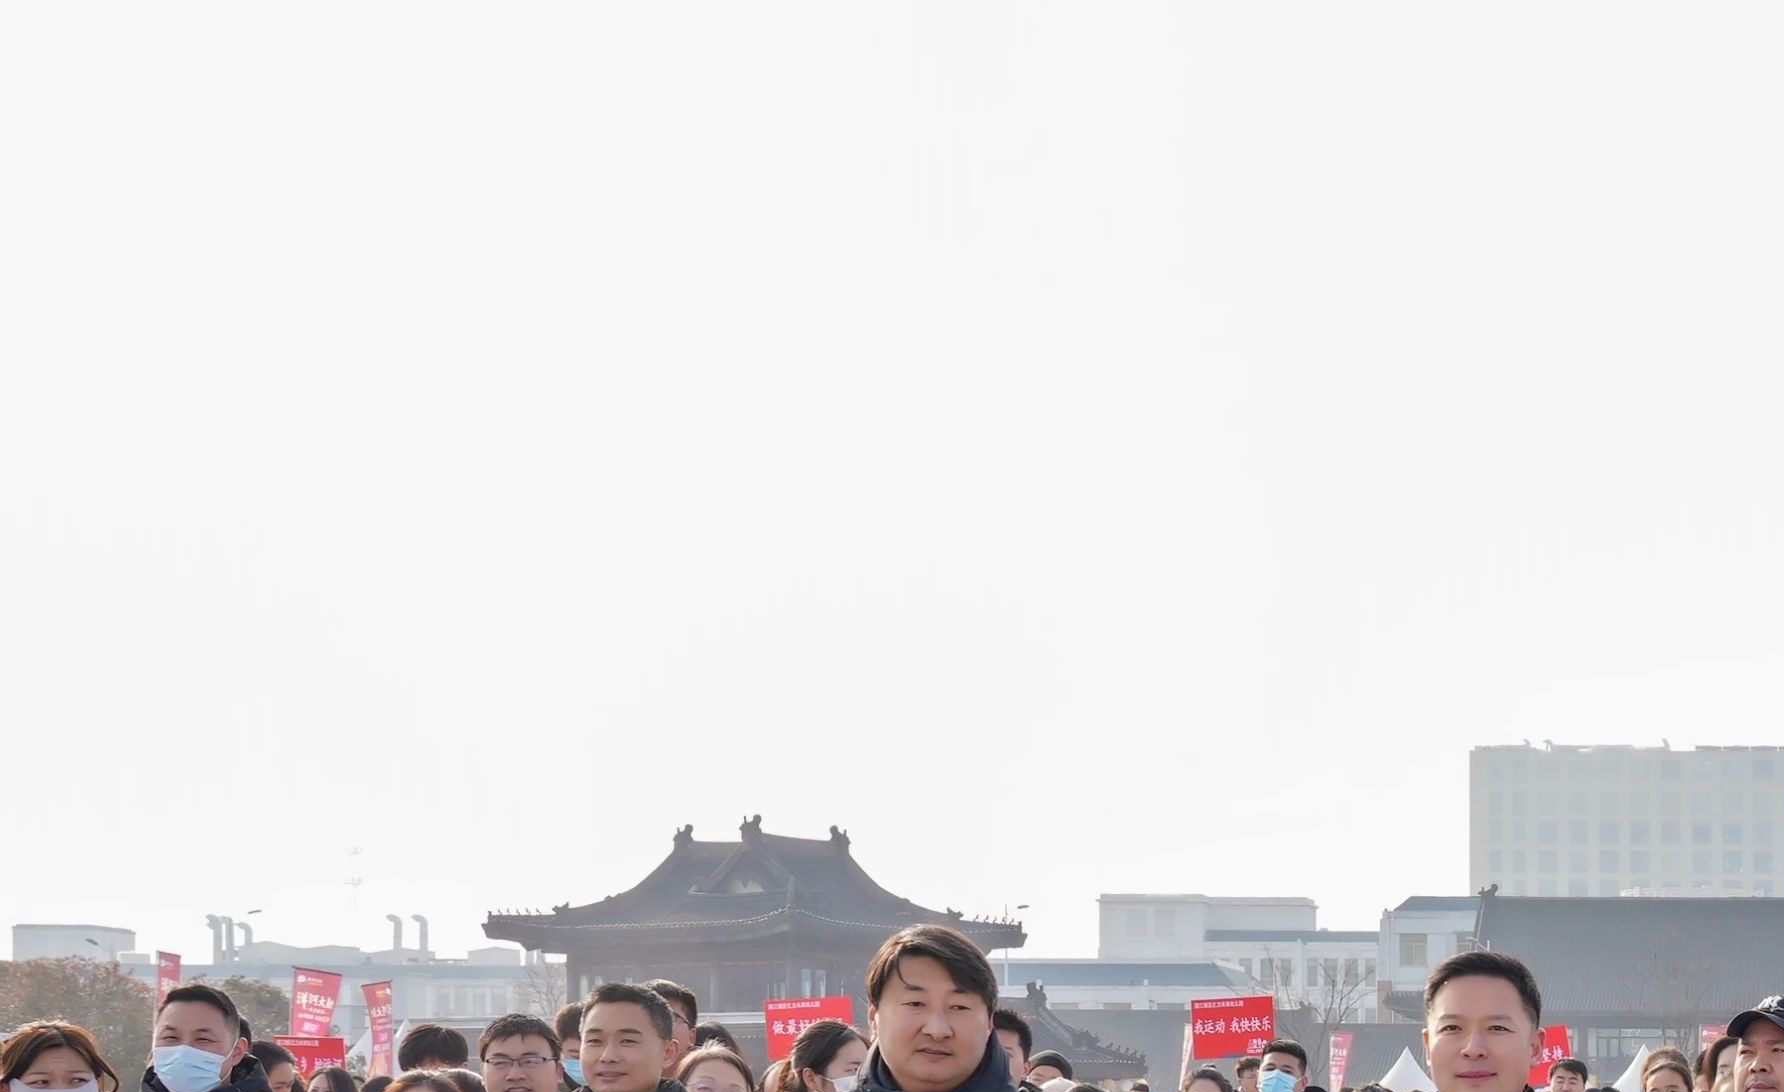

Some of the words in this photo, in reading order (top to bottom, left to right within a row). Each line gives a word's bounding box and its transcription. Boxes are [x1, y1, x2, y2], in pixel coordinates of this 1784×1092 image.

[1194, 1019, 1226, 1035] 我运动
[1229, 1015, 1272, 1034] 我快快乐
